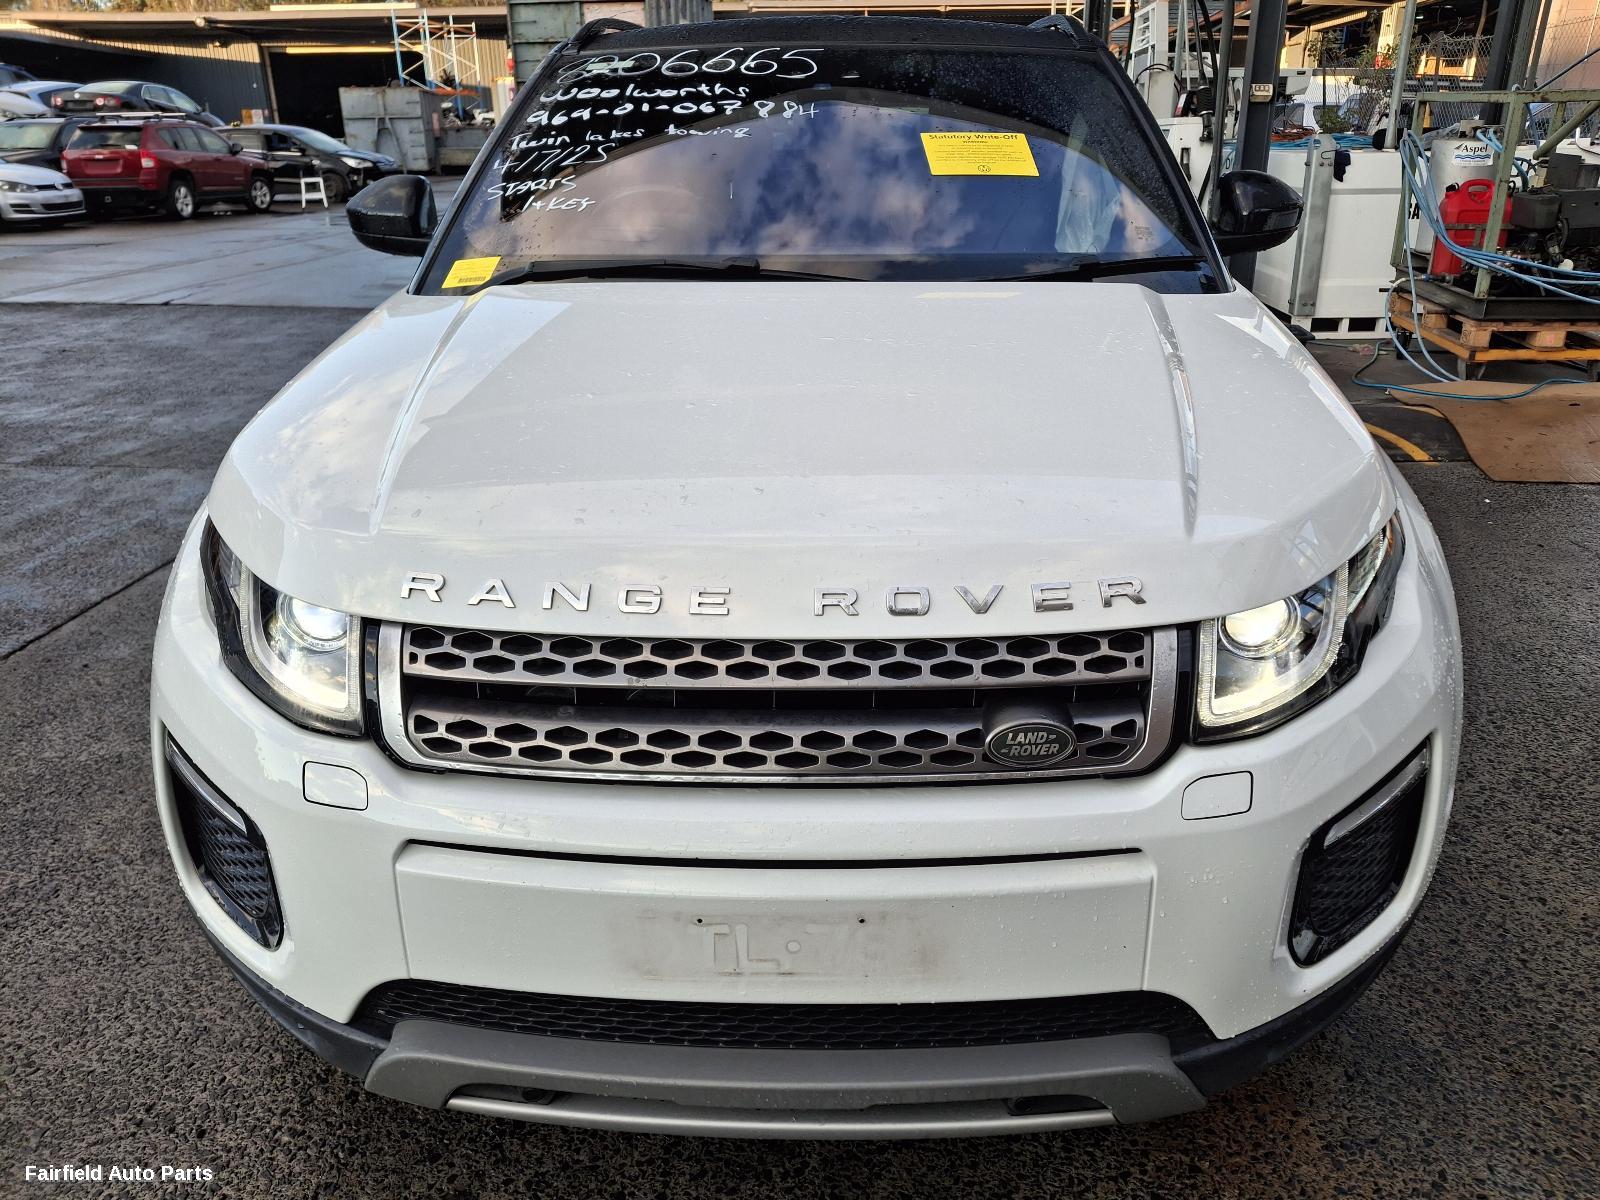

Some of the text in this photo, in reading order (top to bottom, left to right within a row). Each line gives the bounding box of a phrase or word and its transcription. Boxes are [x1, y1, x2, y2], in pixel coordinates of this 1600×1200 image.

[664, 124, 752, 138] towing
[928, 133, 1018, 141] Statutory Write-Off
[1461, 143, 1489, 156] Aspel
[487, 174, 577, 201] STARTS
[400, 570, 1148, 617] RANGE ROVER
